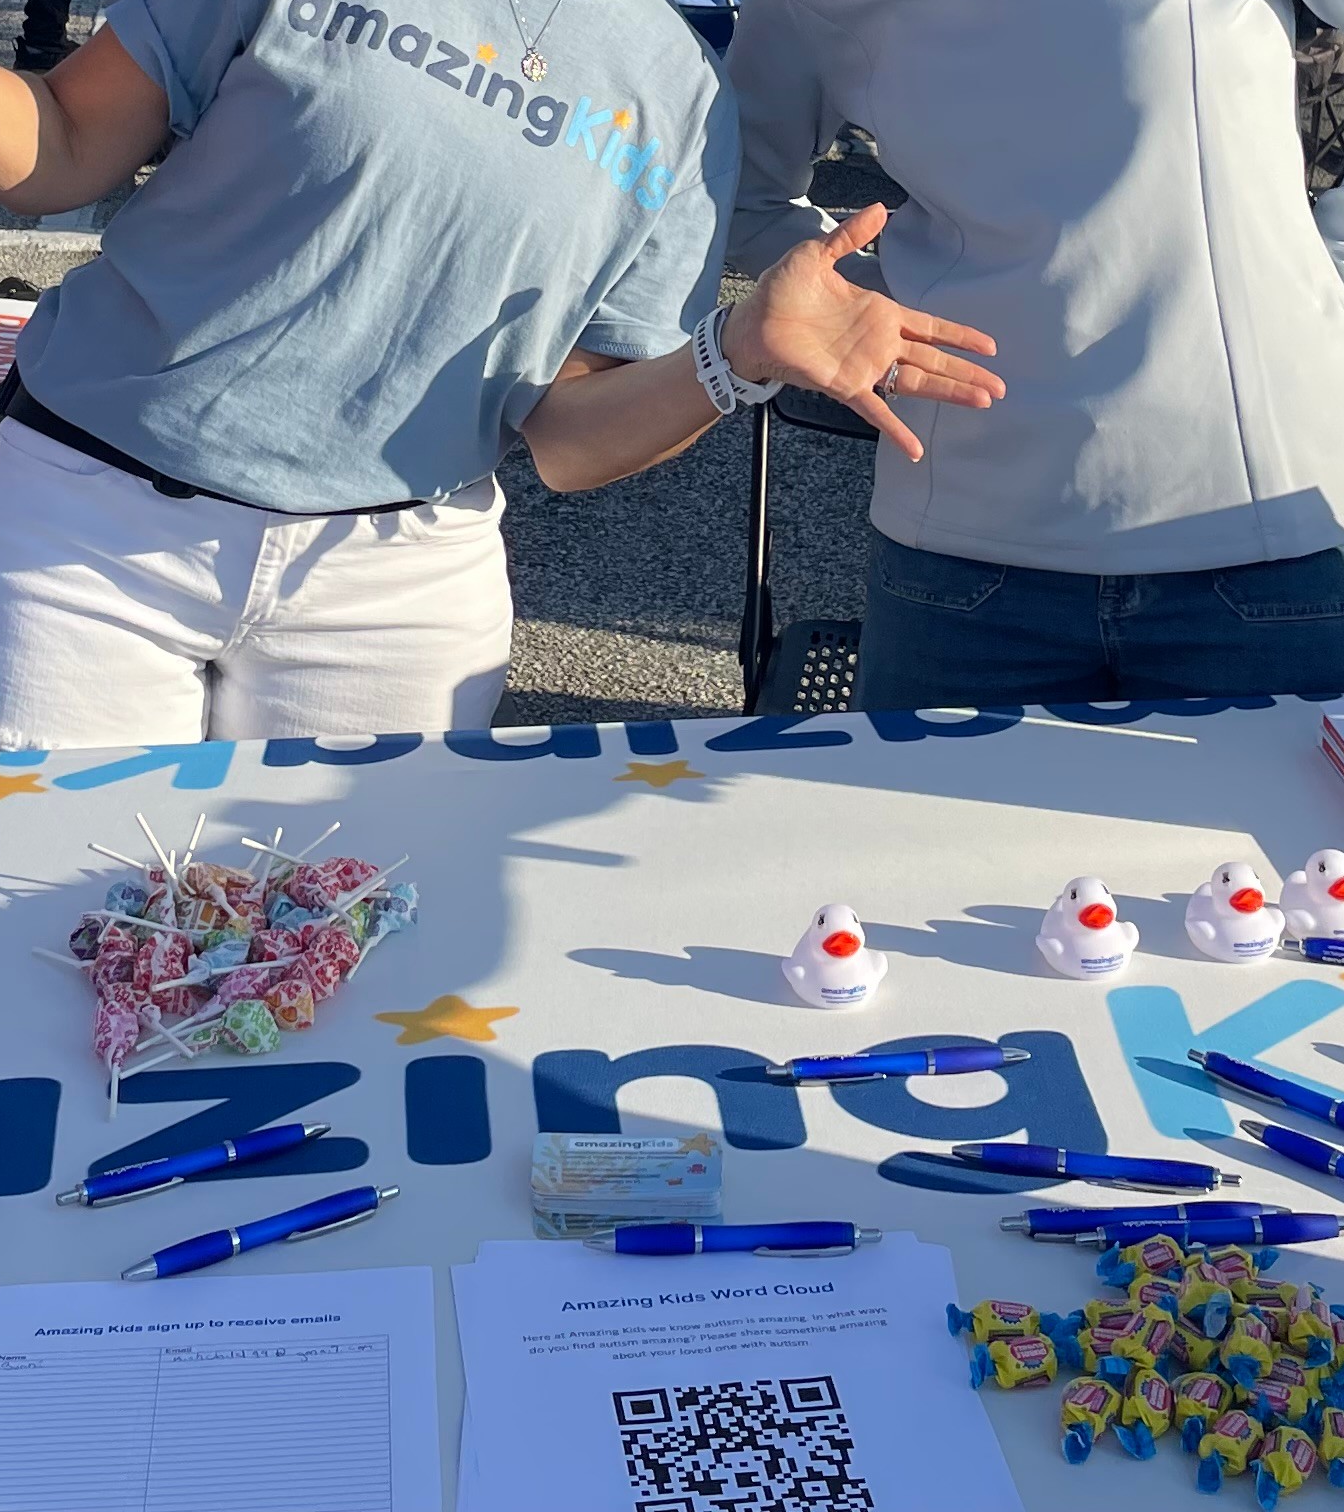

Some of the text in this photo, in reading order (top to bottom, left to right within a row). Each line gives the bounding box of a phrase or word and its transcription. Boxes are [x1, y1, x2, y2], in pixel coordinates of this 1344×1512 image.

[561, 1282, 835, 1313] Amazing Kids Word Cloud
[35, 1313, 341, 1337] Amazing Kids sign up to receive emails
[522, 1335, 551, 1343] Here
[554, 1332, 565, 1340] at
[569, 1329, 620, 1339] Amazing
[622, 1326, 646, 1334] Kids
[649, 1325, 667, 1333] we
[670, 1323, 701, 1332] know
[704, 1318, 743, 1329] autism
[747, 1316, 756, 1324] is
[826, 1310, 855, 1320] what
[859, 1306, 888, 1317] ways
[529, 1318, 888, 1355] do you find autism amazing? Please share something amazing
[612, 1352, 647, 1361] about
[650, 1348, 676, 1359] your
[679, 1345, 712, 1356] loved
[715, 1344, 737, 1353] one
[740, 1340, 766, 1350] with
